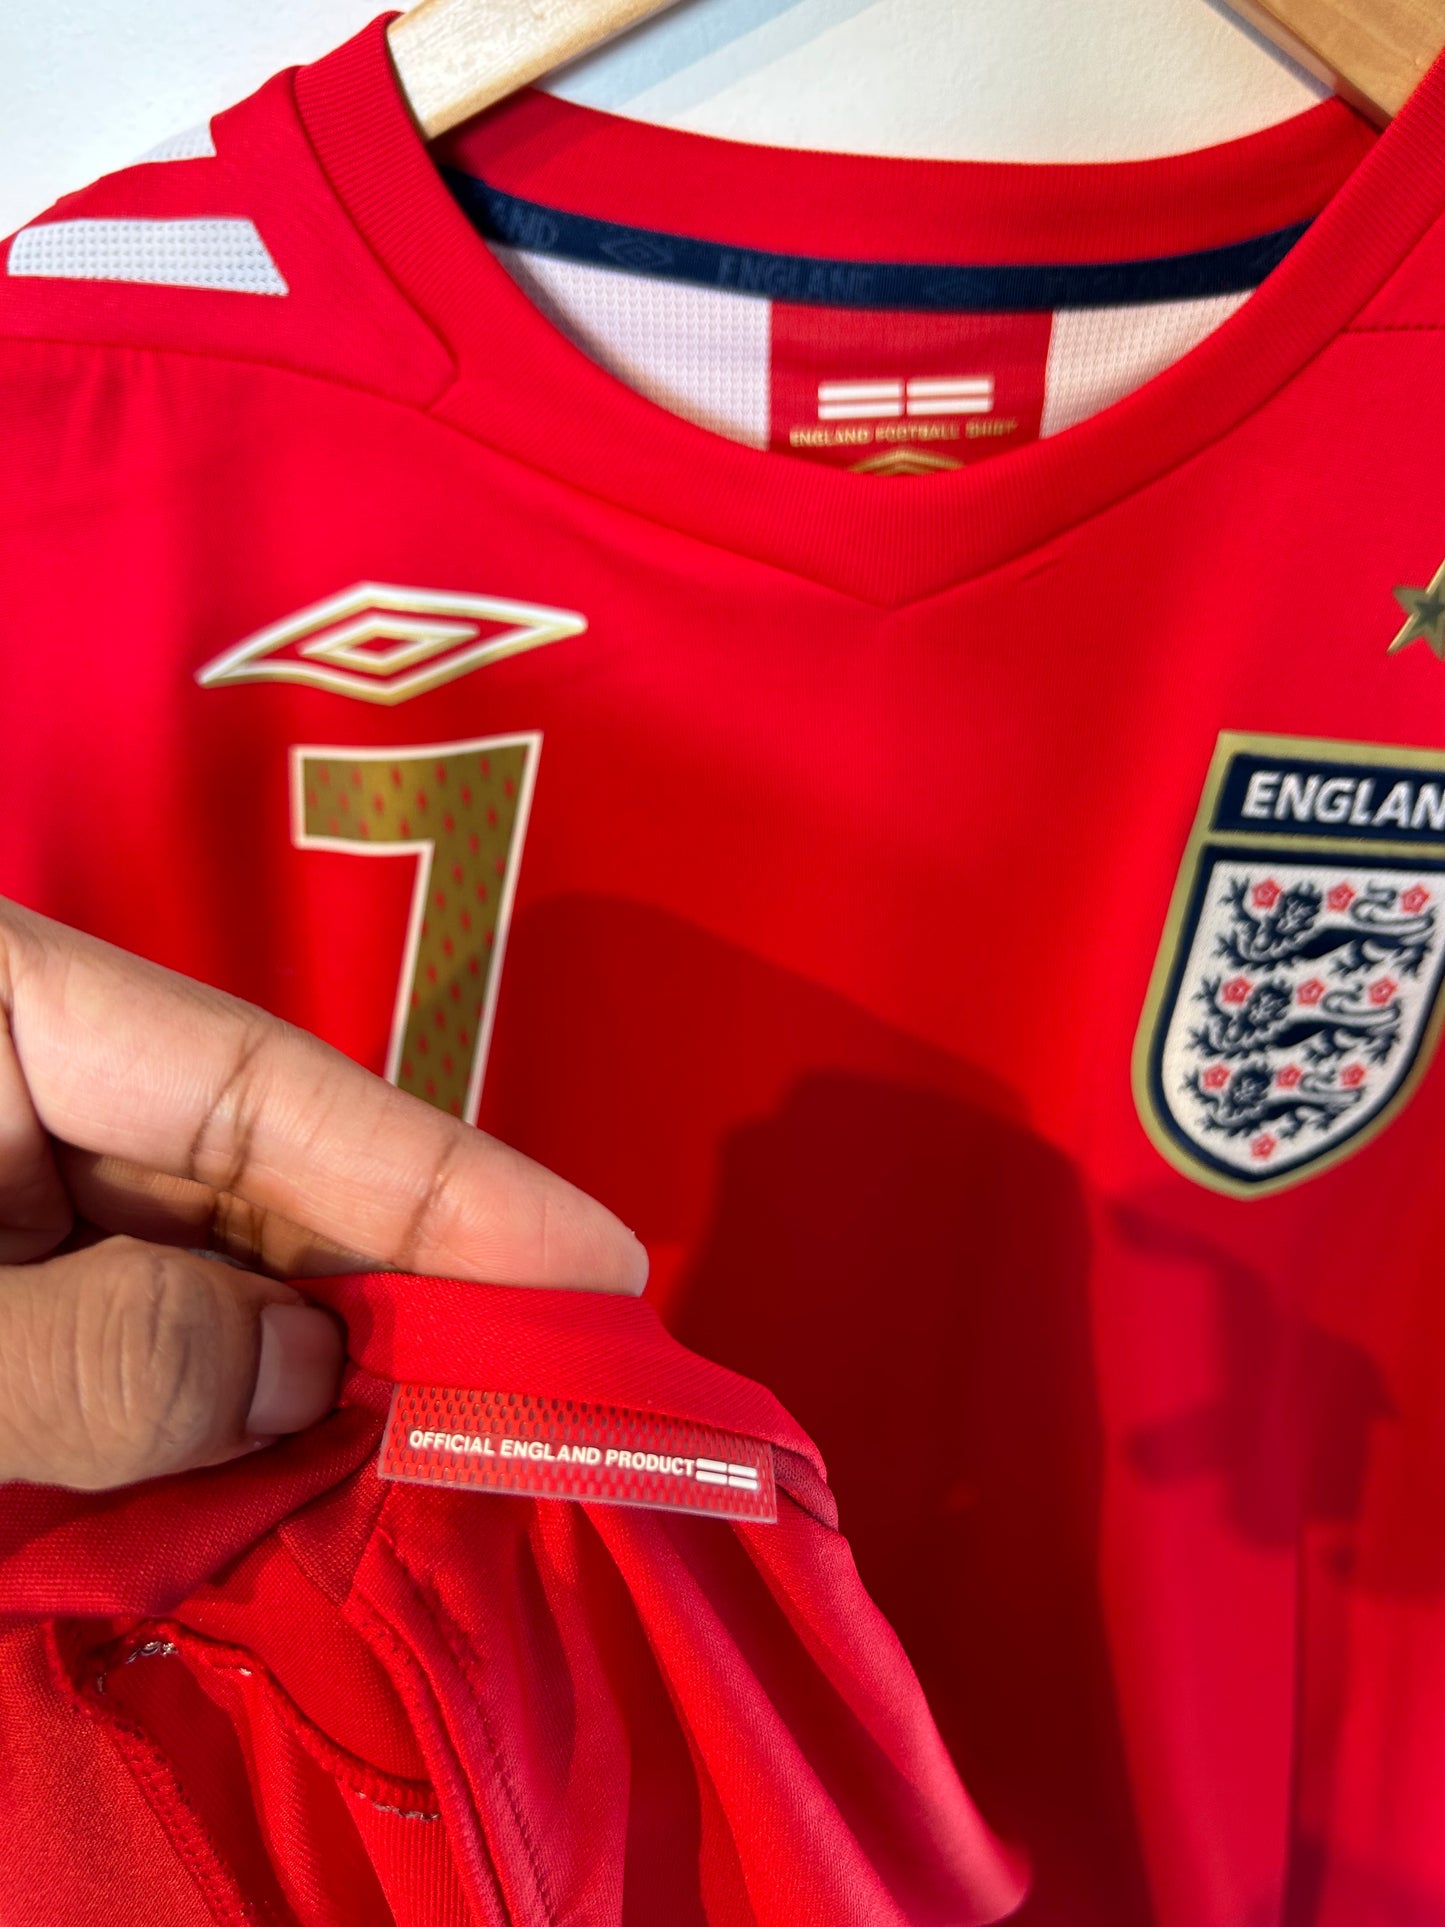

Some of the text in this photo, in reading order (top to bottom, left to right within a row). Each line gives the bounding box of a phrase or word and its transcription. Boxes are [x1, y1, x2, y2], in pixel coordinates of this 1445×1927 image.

[789, 418, 1018, 448] ENGLAND FOOTBALL SHIRT
[409, 1429, 696, 1477] OFFICIAL ENGLAND PRODUCT
